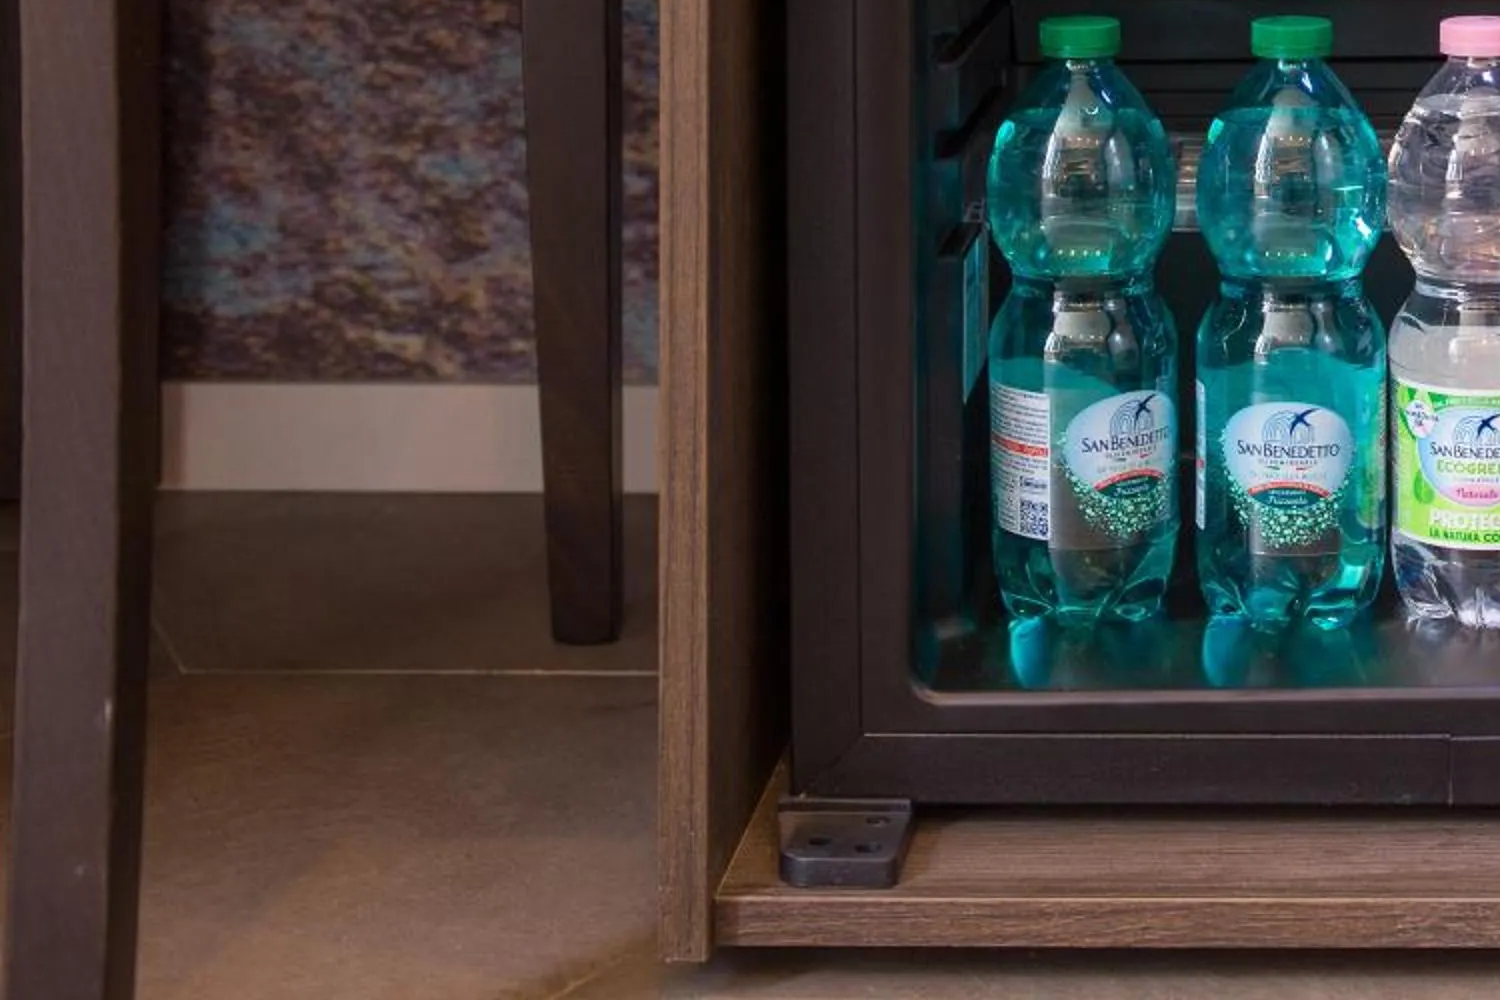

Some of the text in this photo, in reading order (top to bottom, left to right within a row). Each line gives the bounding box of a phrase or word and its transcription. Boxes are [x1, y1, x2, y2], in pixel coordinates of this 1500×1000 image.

[1236, 439, 1341, 459] SAN BENEDETTO
[1430, 441, 1453, 458] SAN
[1429, 528, 1442, 538] LA
[1443, 529, 1482, 542] NATURA
